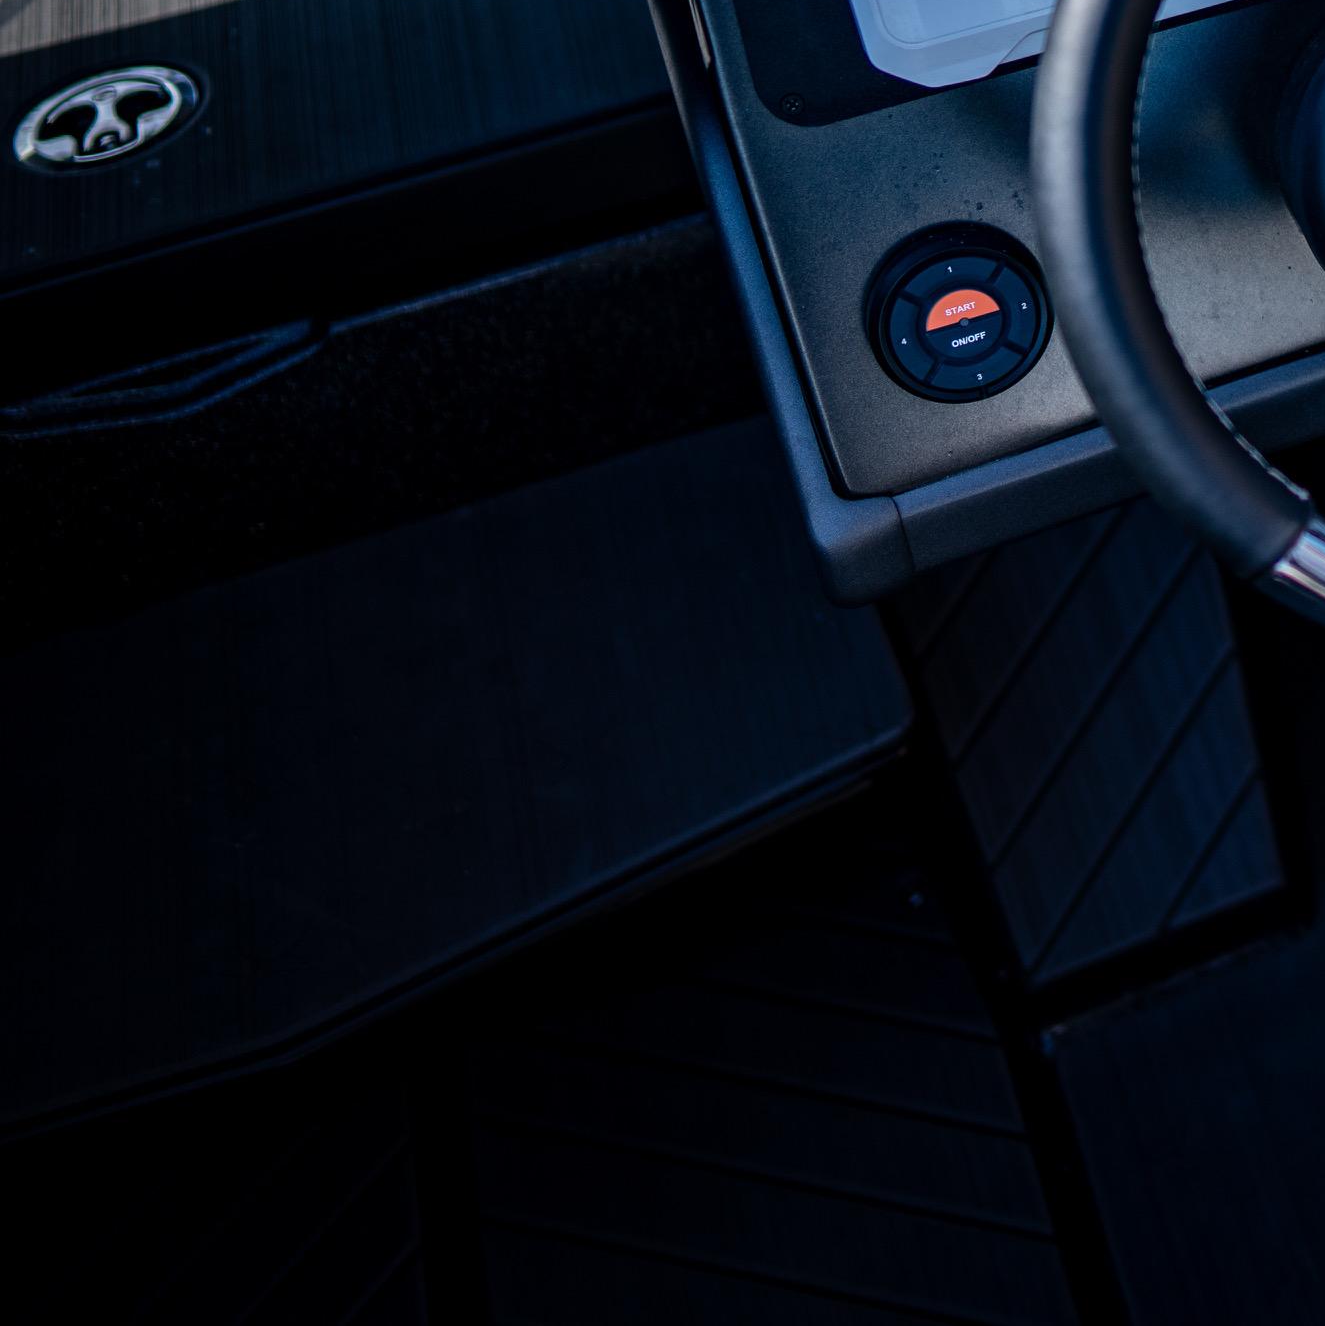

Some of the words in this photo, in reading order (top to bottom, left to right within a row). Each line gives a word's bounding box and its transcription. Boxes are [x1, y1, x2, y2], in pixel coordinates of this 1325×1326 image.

[947, 266, 953, 274] 1
[945, 302, 976, 317] START
[1021, 302, 1028, 310] 2
[901, 338, 907, 346] 4
[951, 331, 986, 348] ON/OFF
[977, 373, 983, 381] 3
